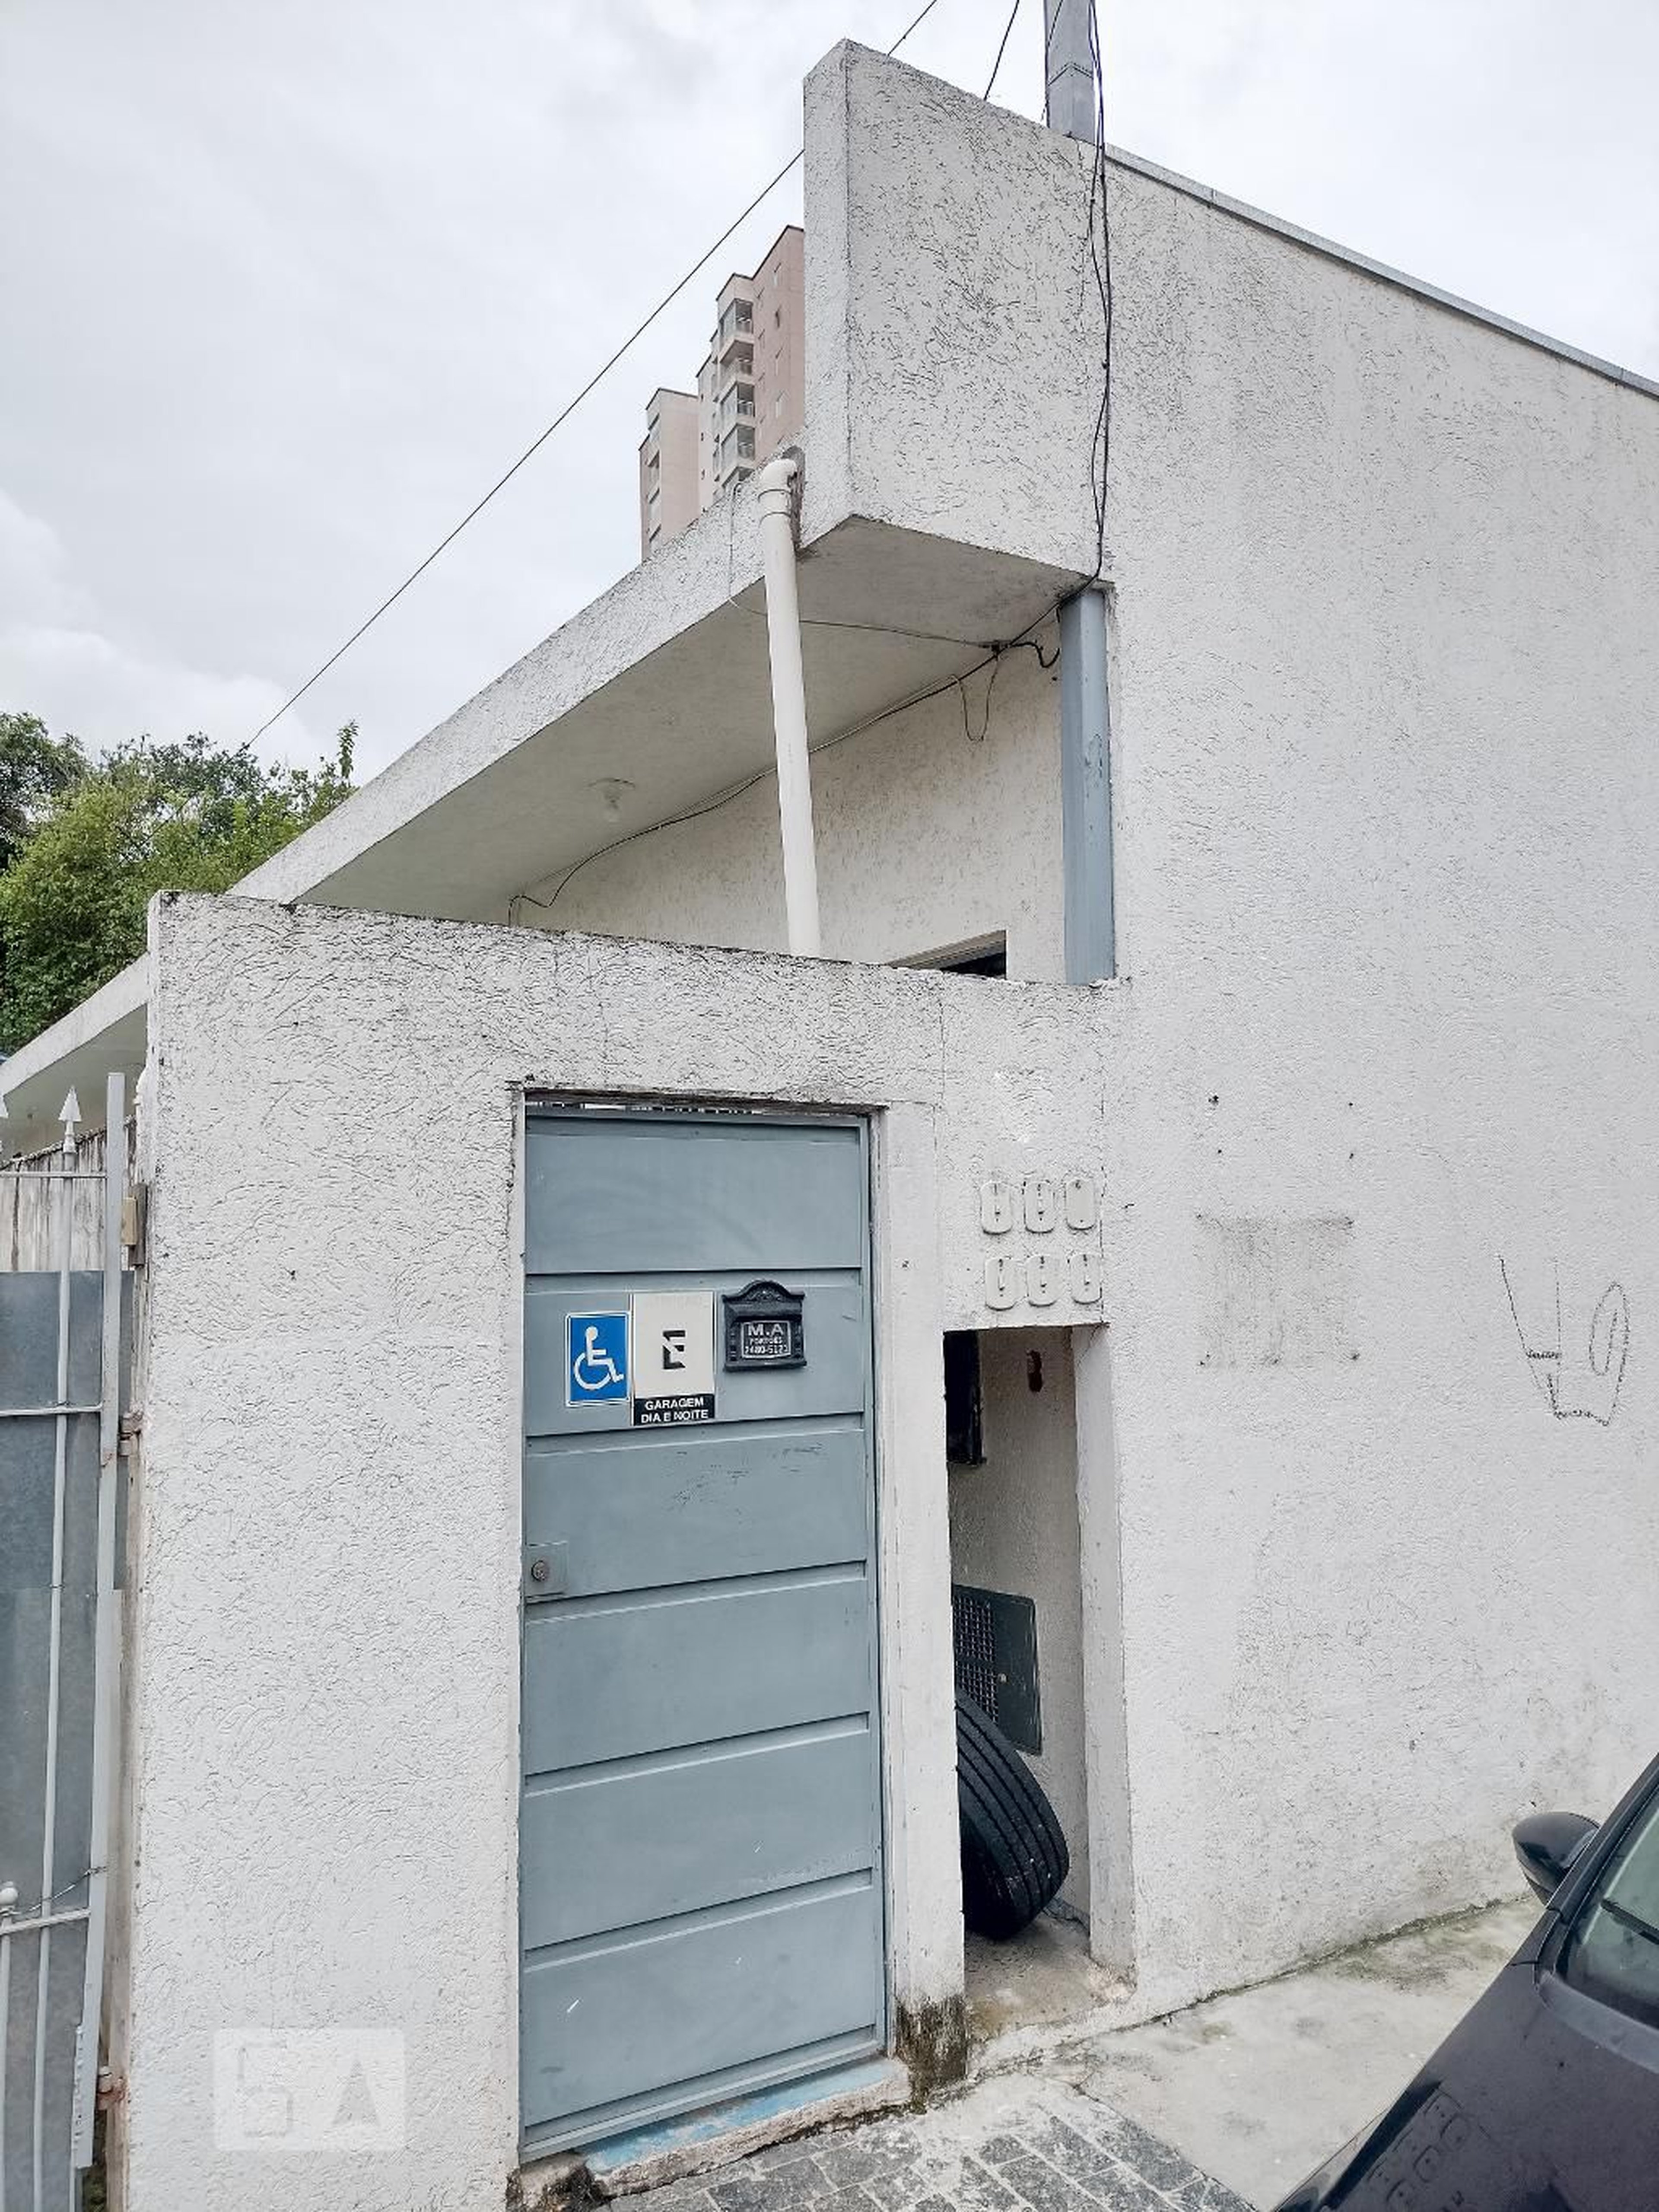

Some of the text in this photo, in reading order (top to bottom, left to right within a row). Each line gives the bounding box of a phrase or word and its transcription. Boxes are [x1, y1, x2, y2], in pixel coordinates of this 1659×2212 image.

[645, 1397, 704, 1410] GARAGEM
[641, 1409, 709, 1423] DIA E NOITE
